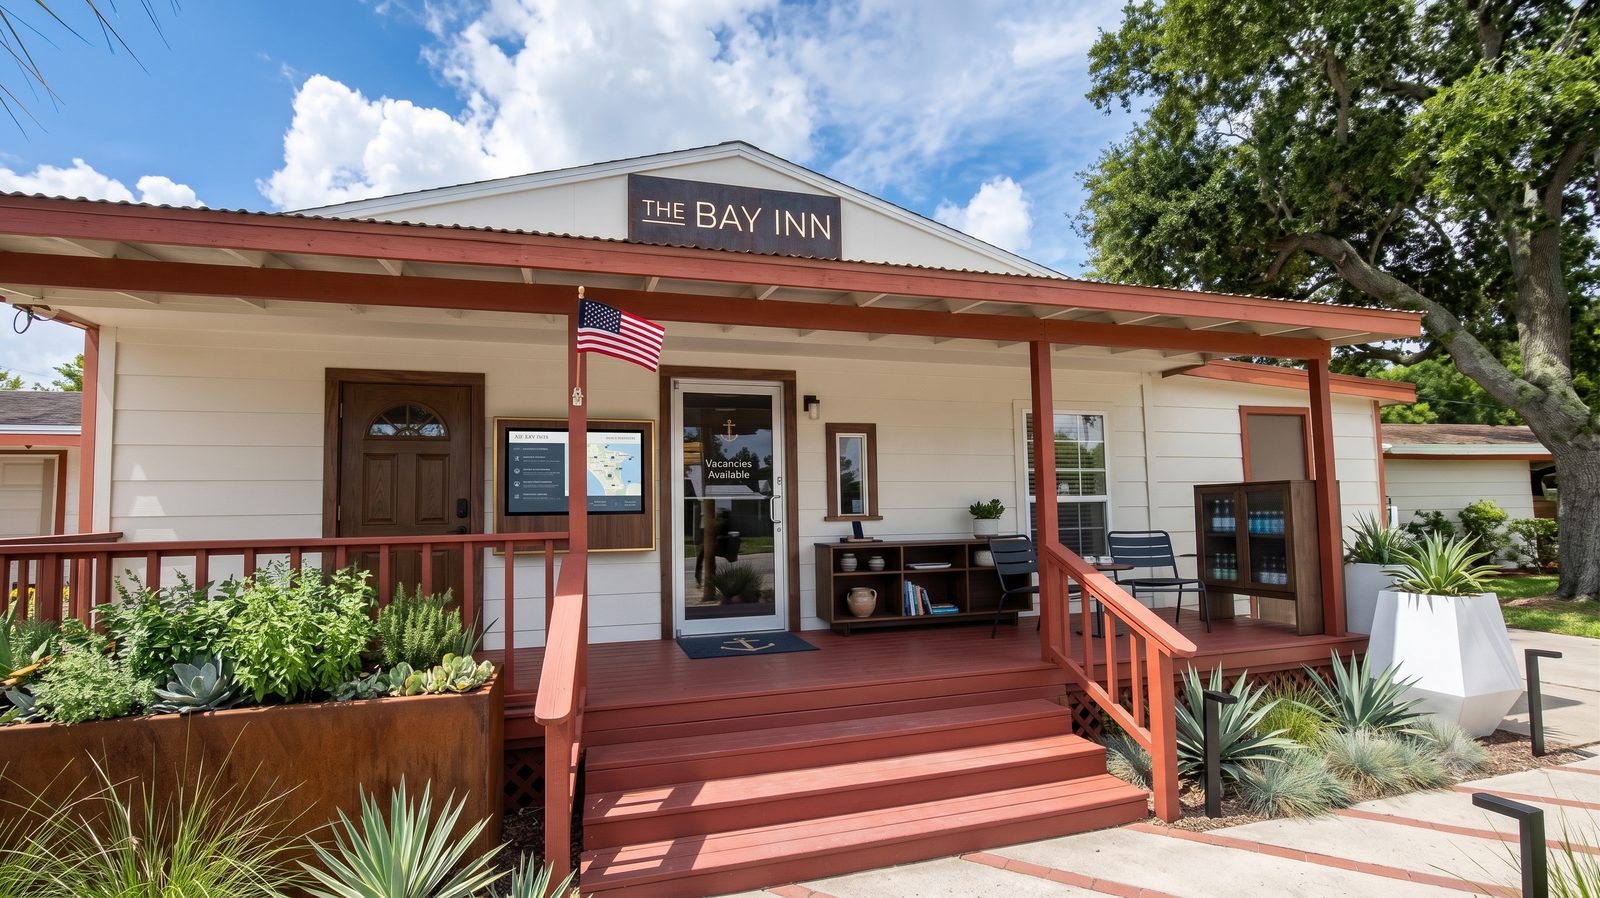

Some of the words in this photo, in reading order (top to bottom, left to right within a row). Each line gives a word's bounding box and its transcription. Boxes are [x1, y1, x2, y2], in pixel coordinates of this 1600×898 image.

[642, 200, 685, 219] THE
[696, 201, 762, 233] BAY
[775, 209, 831, 240] INN
[705, 459, 752, 468] Vacancies
[708, 470, 750, 479] Available
